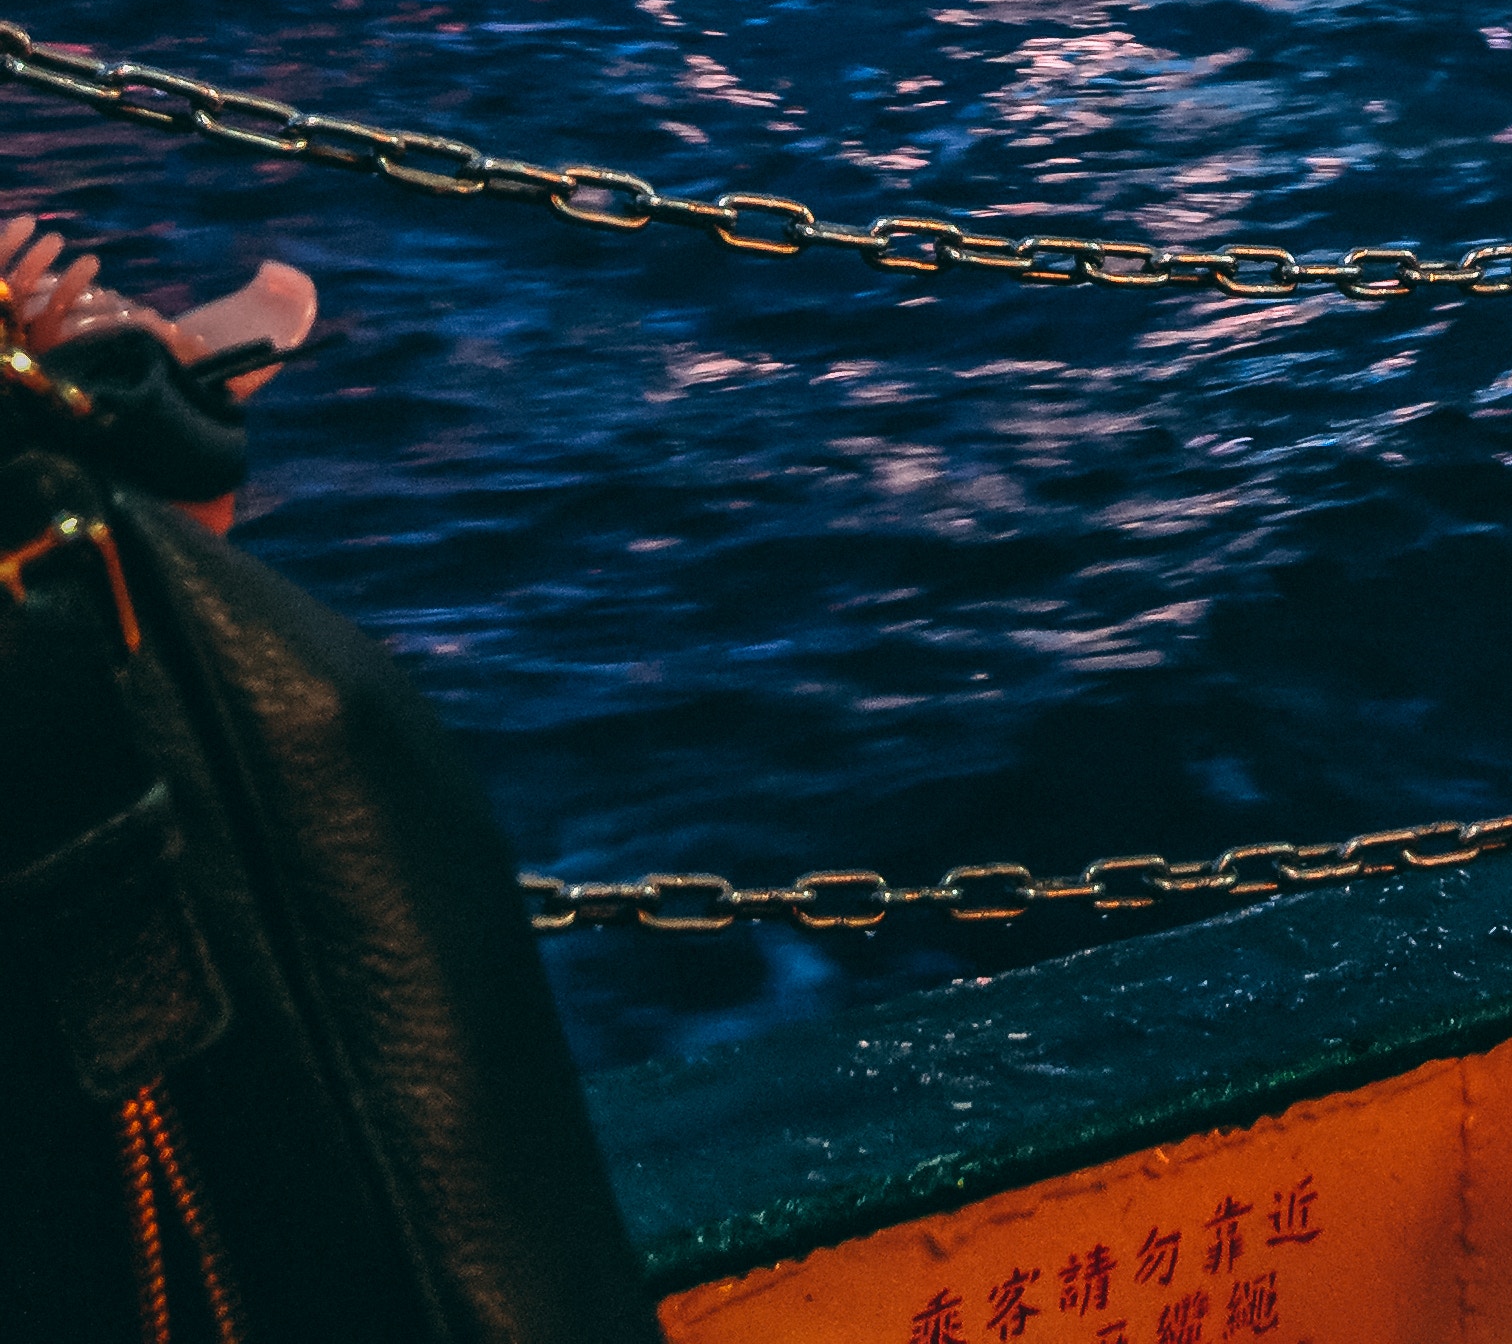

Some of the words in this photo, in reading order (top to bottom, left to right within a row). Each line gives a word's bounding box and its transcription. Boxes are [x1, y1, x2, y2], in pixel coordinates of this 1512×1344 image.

[911, 1174, 1322, 1344] 乘客請勿靠近
